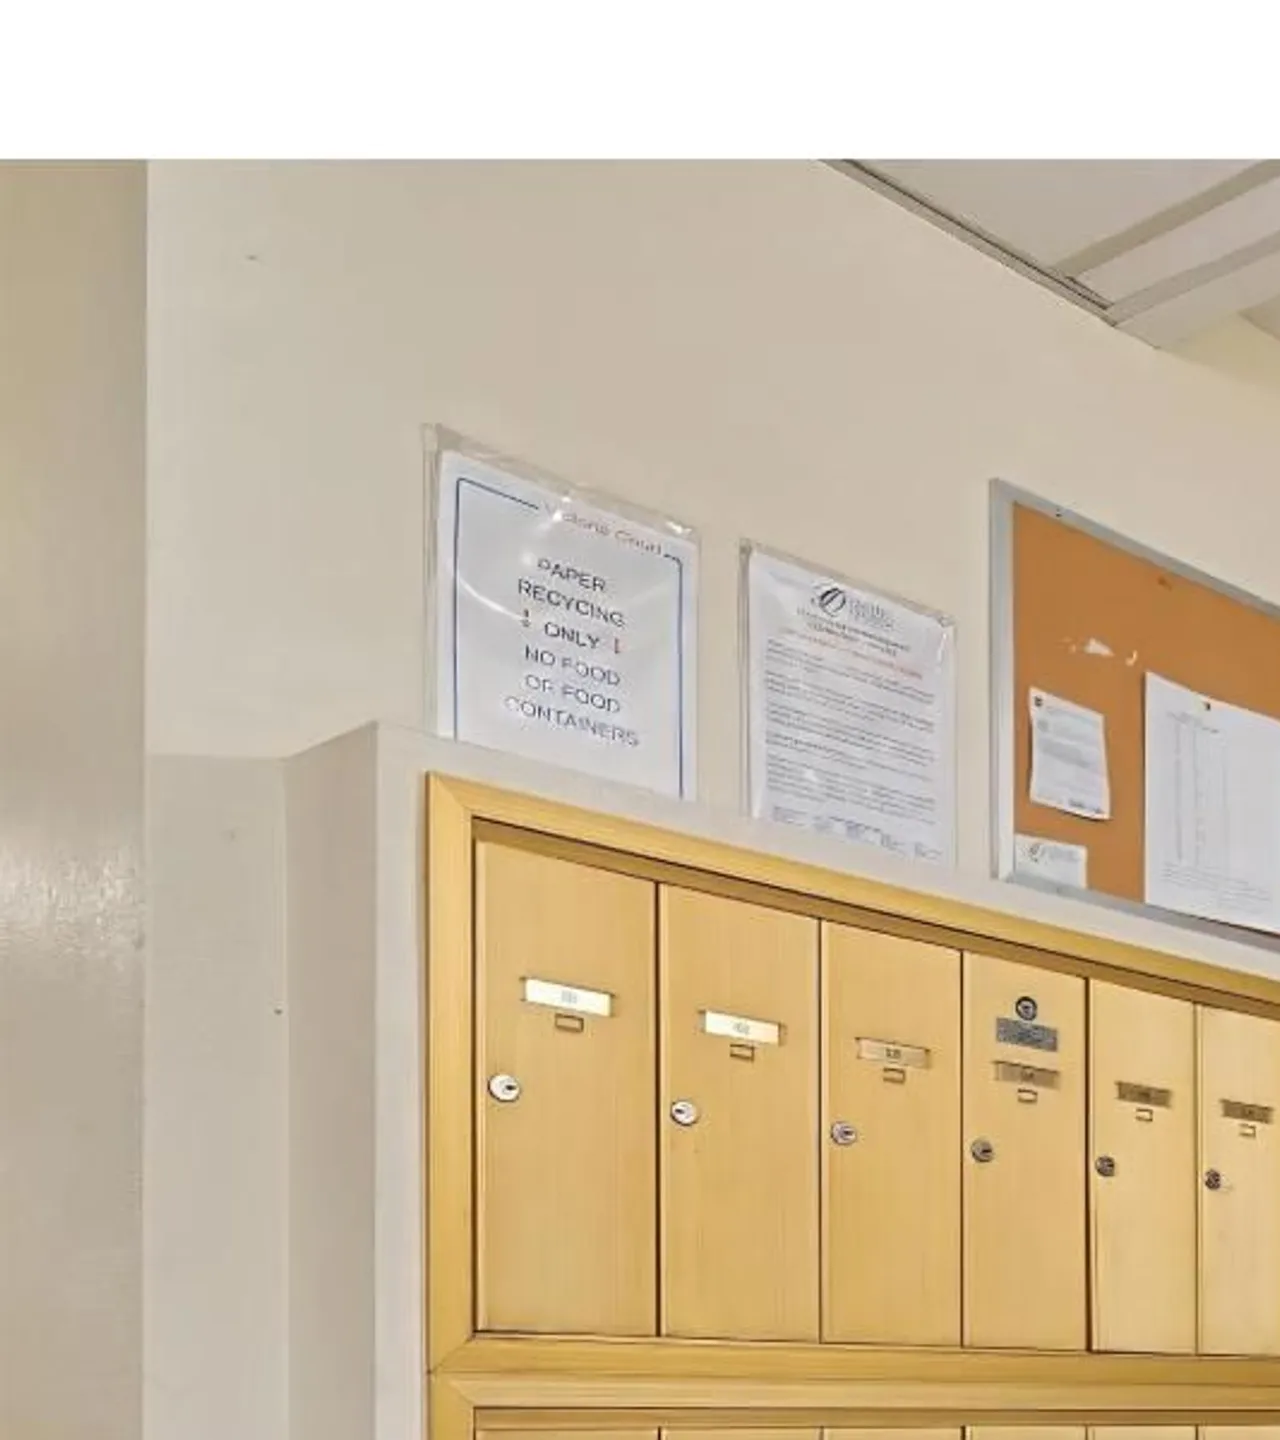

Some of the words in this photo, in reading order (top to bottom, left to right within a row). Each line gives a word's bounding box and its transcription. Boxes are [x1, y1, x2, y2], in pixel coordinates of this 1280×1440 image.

[537, 558, 606, 591] PAPER
[518, 578, 627, 628] RECYCING
[544, 622, 600, 649] ONLY
[525, 645, 555, 666] NO
[562, 657, 621, 686] FOOD
[562, 685, 621, 713] FOOD
[504, 696, 640, 747] CONTAINERS
